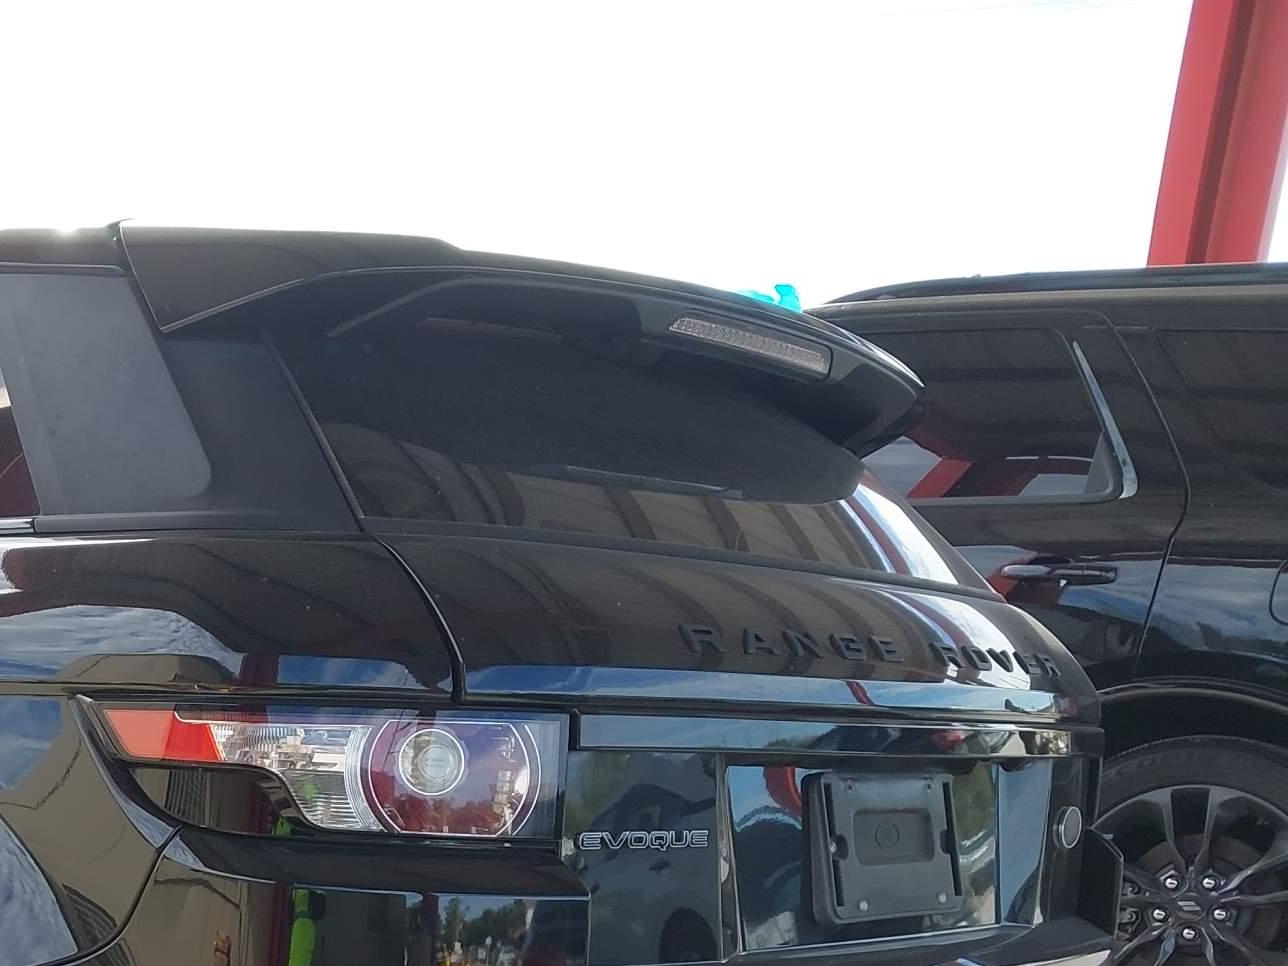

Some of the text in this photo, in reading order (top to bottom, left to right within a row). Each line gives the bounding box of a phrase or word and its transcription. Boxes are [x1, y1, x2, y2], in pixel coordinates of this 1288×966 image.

[678, 623, 1062, 678] RANGE ROVER
[579, 828, 710, 852] EVOQUE
